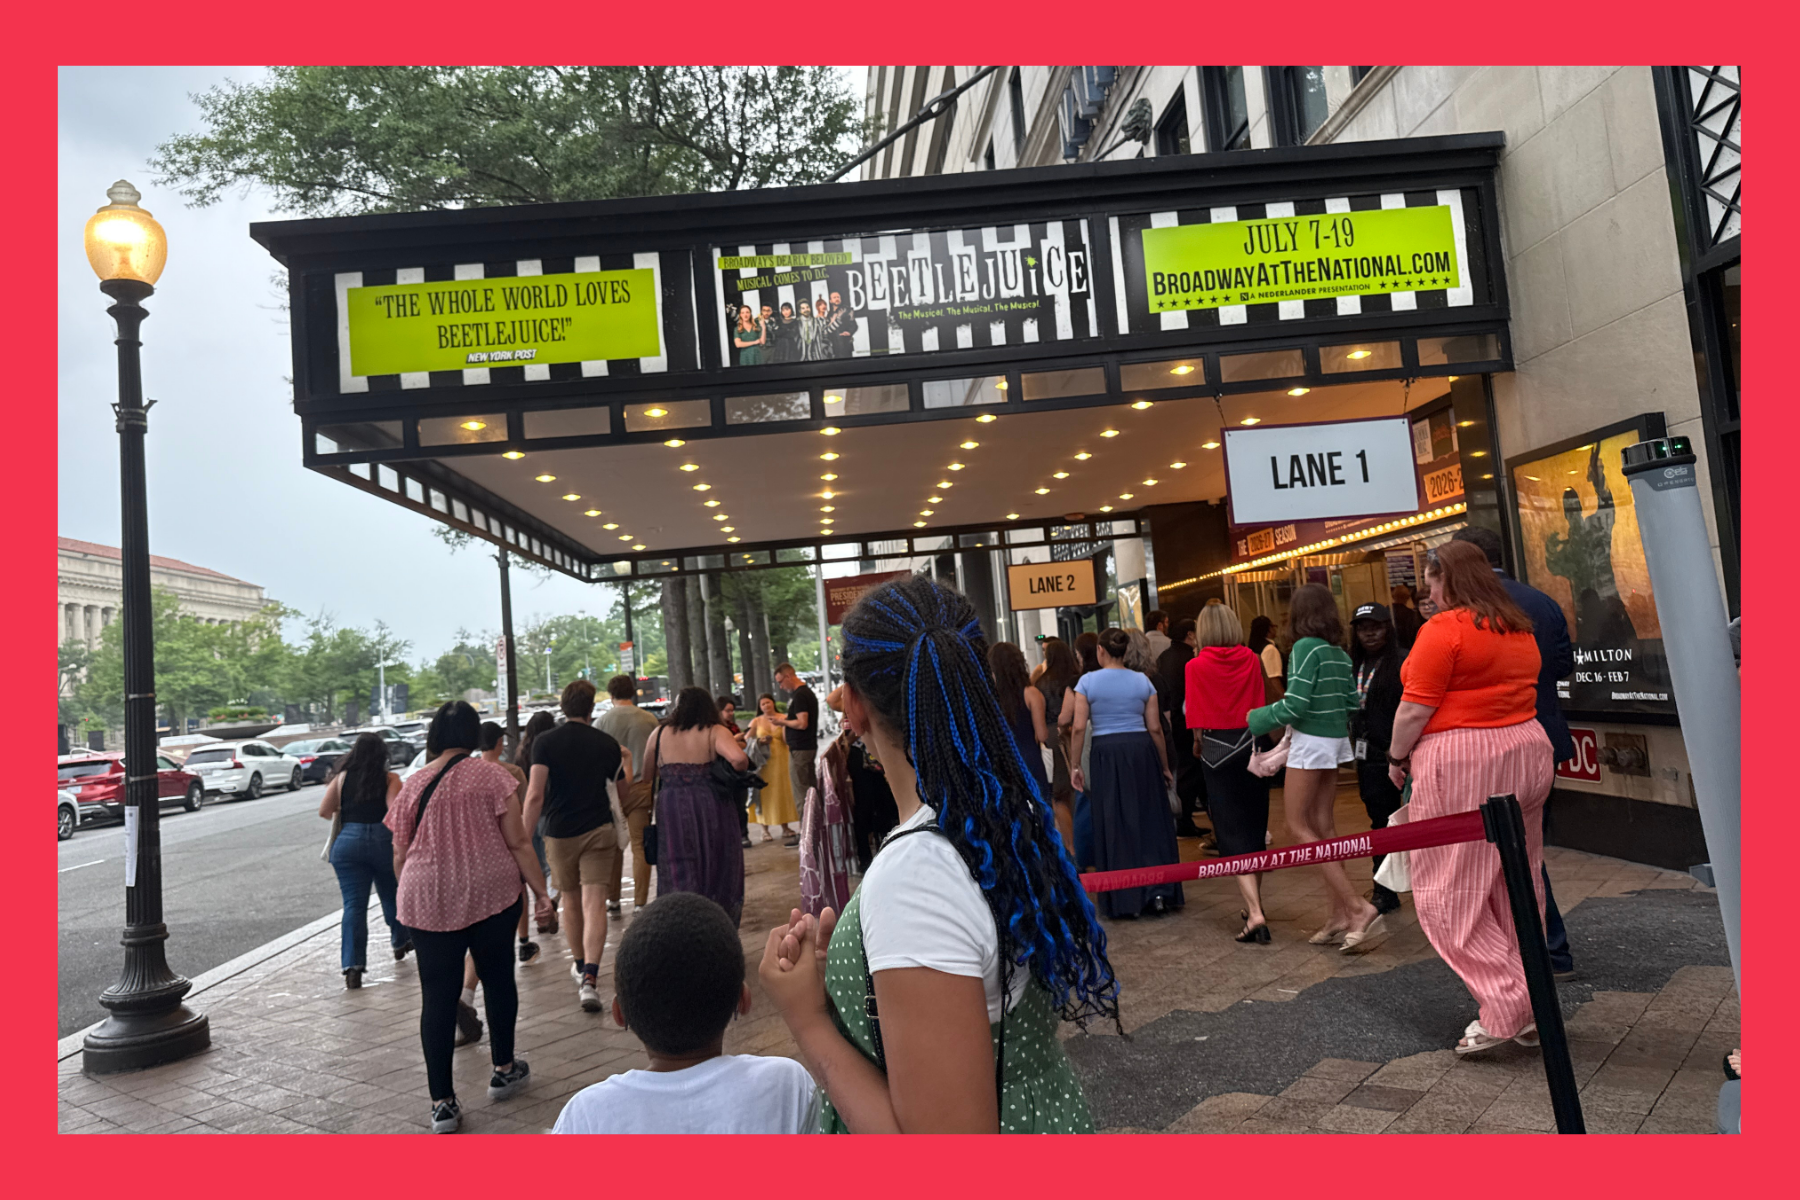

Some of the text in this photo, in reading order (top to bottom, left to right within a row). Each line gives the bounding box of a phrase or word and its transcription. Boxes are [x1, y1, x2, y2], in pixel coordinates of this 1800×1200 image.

[1243, 217, 1356, 255] JULY 7-19
[724, 253, 847, 268] BROADWAY'S DEARLY BELOVED
[736, 267, 830, 291] MUSICAL COMES TO D.C.
[374, 279, 632, 319] “THE WHOLE WORLD LOVES
[1258, 289, 1317, 299] NEDERLANDER
[1318, 284, 1371, 294] PRESENTATION
[898, 300, 1041, 320] The Musical. The Musical. The Musical.
[437, 317, 572, 349] BEETLEJUICE!”
[466, 348, 538, 363] NEW YORK POST
[1270, 449, 1370, 490] LANE 1
[1029, 574, 1076, 594] LANE 2
[1575, 672, 1593, 683] DEC
[1594, 671, 1603, 682] 16
[1608, 671, 1624, 682] FEB
[1624, 671, 1630, 682] 7
[1199, 836, 1373, 878] BROADWAY AT THE NATIONAL
